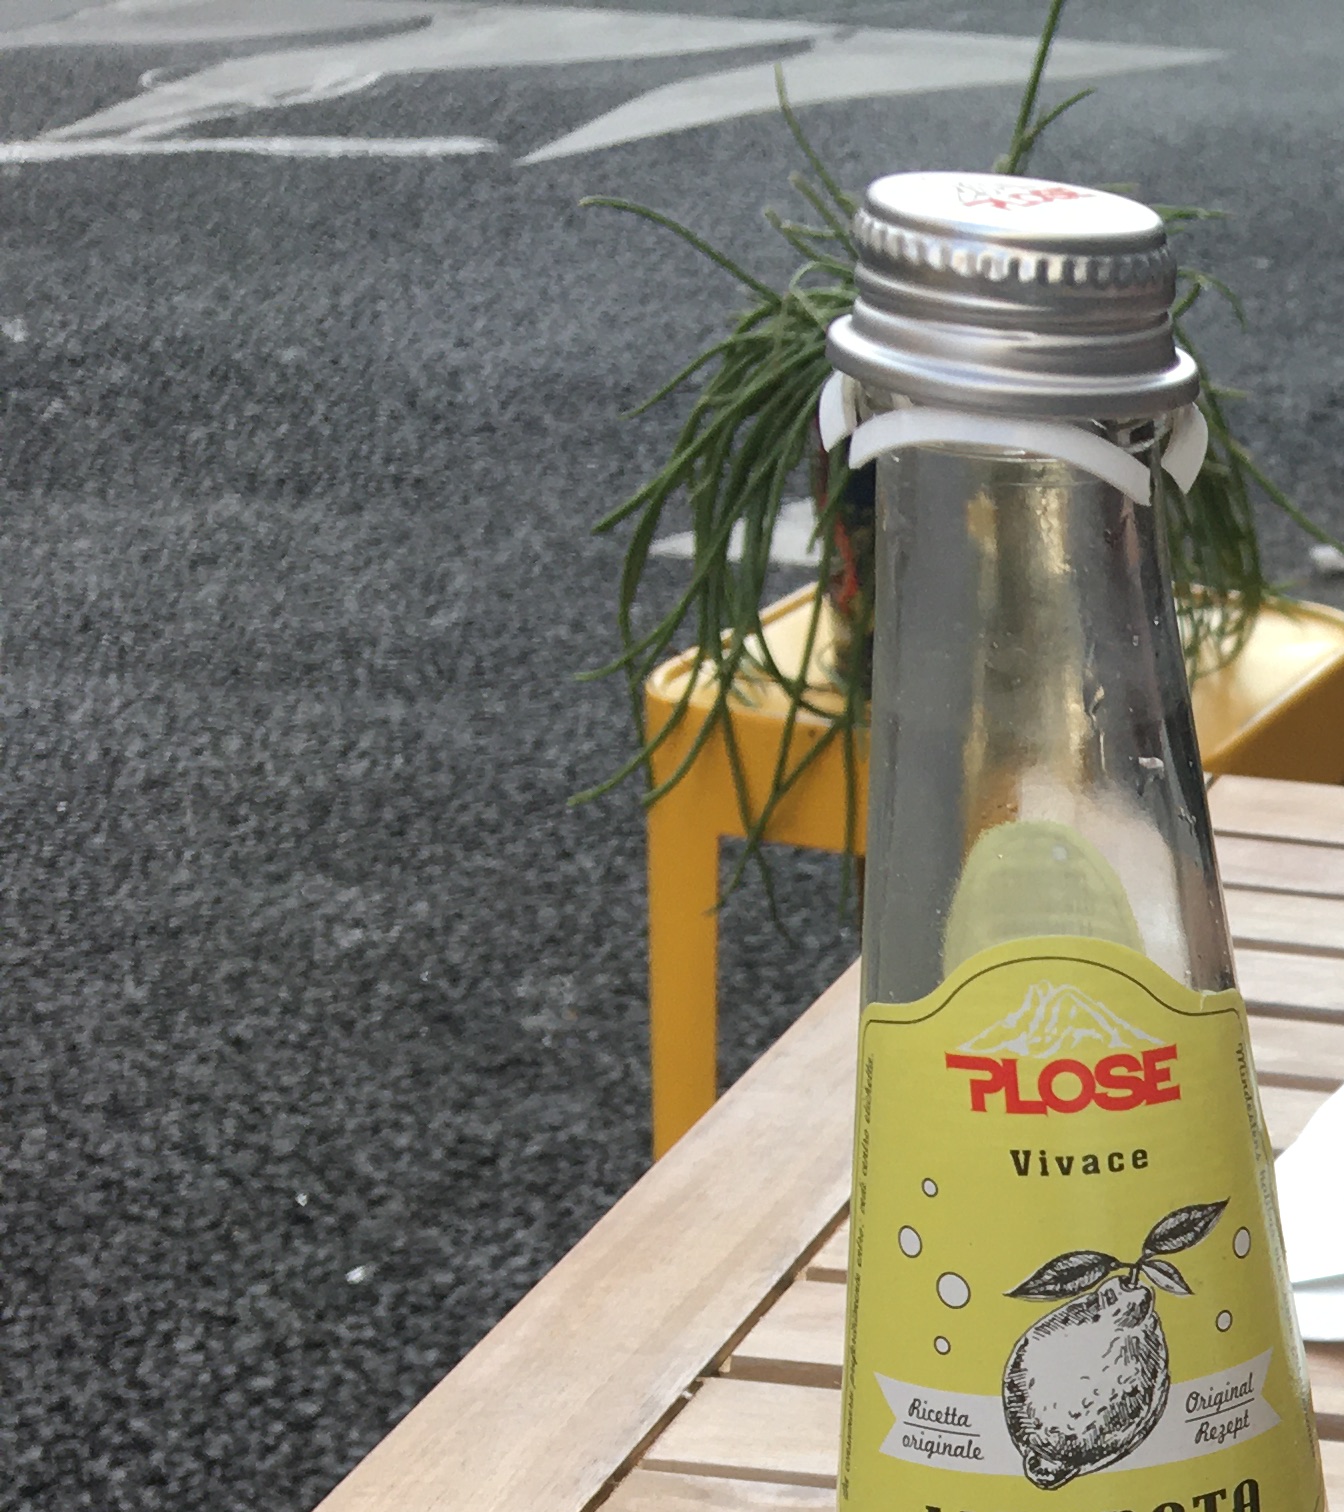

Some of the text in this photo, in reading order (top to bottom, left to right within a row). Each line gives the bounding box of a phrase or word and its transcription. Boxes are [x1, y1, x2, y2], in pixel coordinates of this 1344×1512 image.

[945, 1045, 1181, 1116] PLOSE
[1009, 1147, 1150, 1179] Vivace
[1185, 1371, 1255, 1415] Original
[907, 1397, 973, 1428] Ricetta
[1193, 1413, 1252, 1447] Rezept
[902, 1434, 985, 1461] originale
